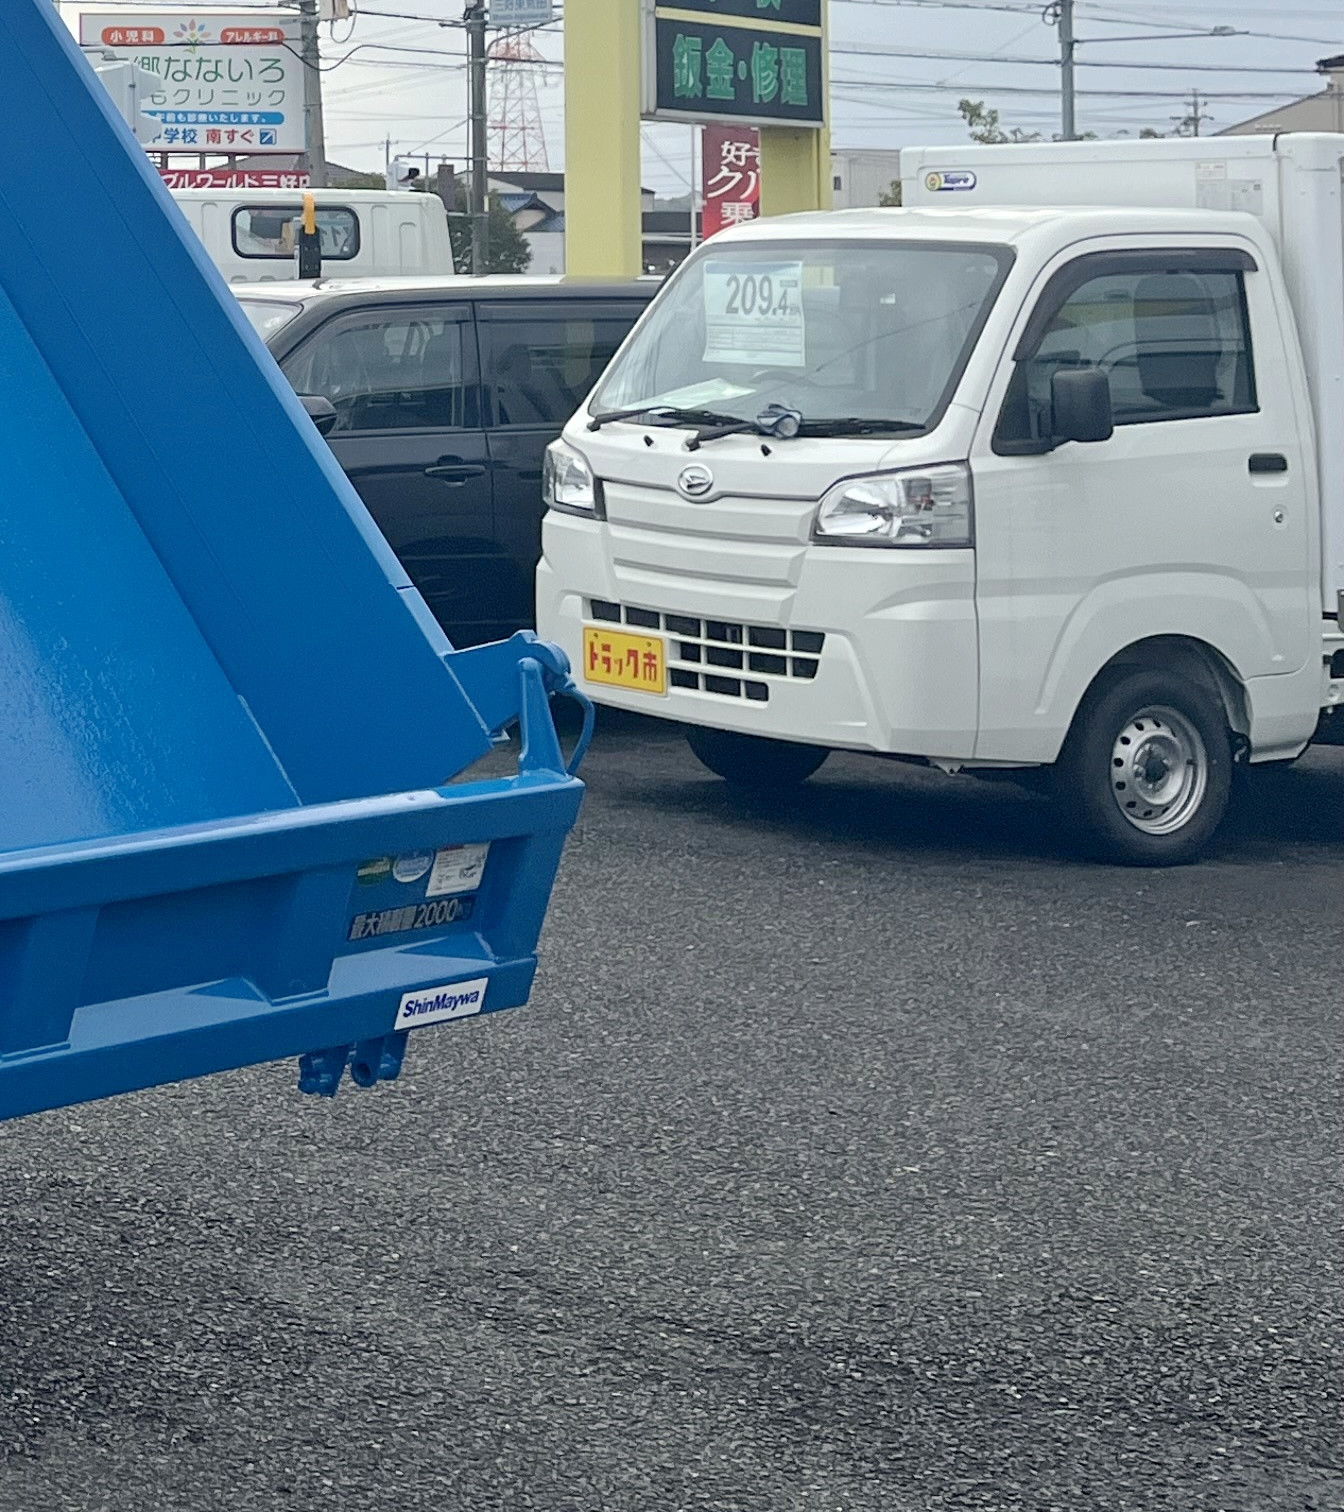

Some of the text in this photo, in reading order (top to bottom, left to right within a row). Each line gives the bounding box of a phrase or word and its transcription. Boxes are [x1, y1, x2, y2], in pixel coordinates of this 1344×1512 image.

[110, 29, 154, 43] 小児科
[672, 34, 808, 106] 鈑金・修理
[590, 640, 657, 683] トラック市
[403, 990, 480, 1018] ShinMaywa
